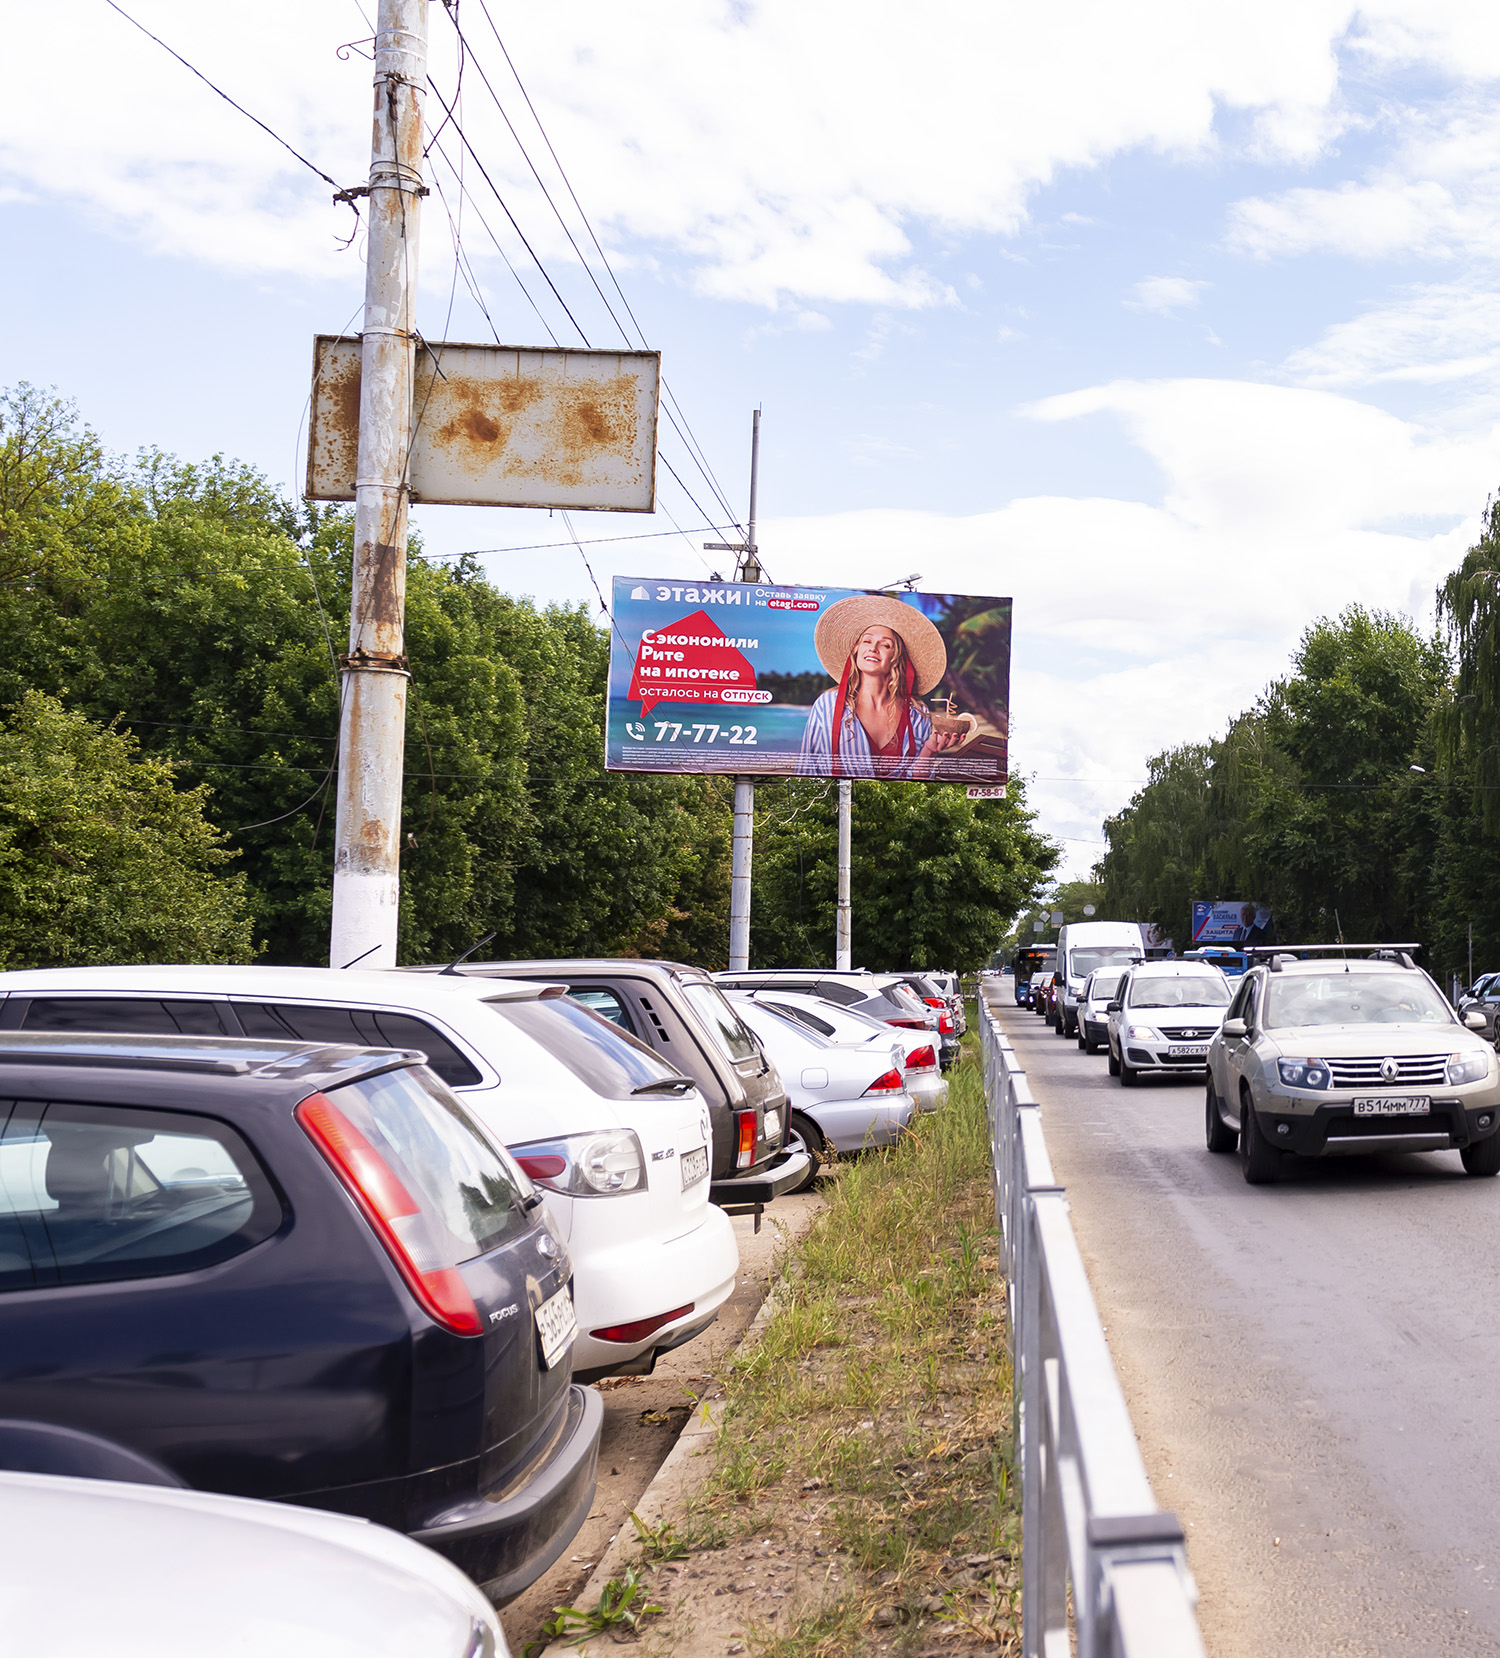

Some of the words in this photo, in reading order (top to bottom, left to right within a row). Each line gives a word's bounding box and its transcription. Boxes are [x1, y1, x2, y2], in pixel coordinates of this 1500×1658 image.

[755, 589, 791, 599] Оставь
[793, 592, 826, 602] заявку
[755, 599, 766, 607] на
[769, 600, 818, 610] etagi.com
[641, 629, 759, 649] Сэкономили
[641, 645, 685, 662] Рите
[640, 666, 661, 678] на
[665, 668, 740, 681] ипотеке
[639, 687, 700, 699] осталось
[703, 689, 719, 699] на
[723, 690, 770, 703] отпуск
[654, 721, 758, 745] 77-77-22
[968, 788, 1004, 797] 47-58-87
[488, 1303, 519, 1324] FOCUS
